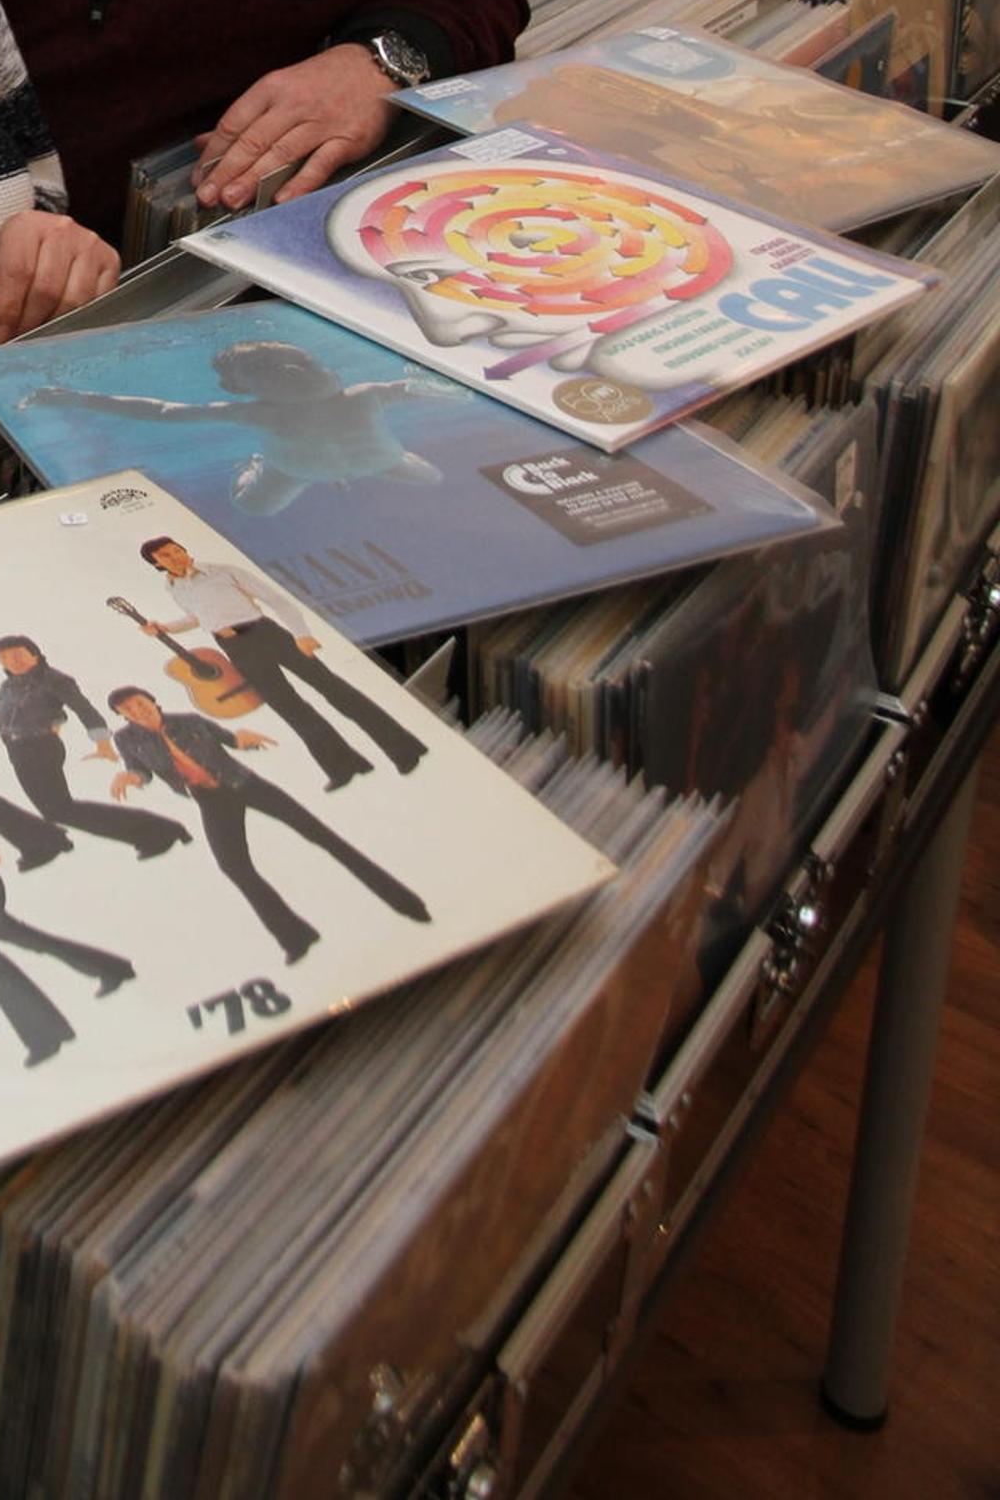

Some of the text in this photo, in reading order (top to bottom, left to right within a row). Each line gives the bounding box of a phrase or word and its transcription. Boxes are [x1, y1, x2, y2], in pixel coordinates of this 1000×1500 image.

[718, 257, 897, 332] CALL
[523, 457, 571, 474] Back
[545, 471, 600, 491] Black
[267, 538, 409, 595] VANA
[186, 977, 293, 1036] '78
